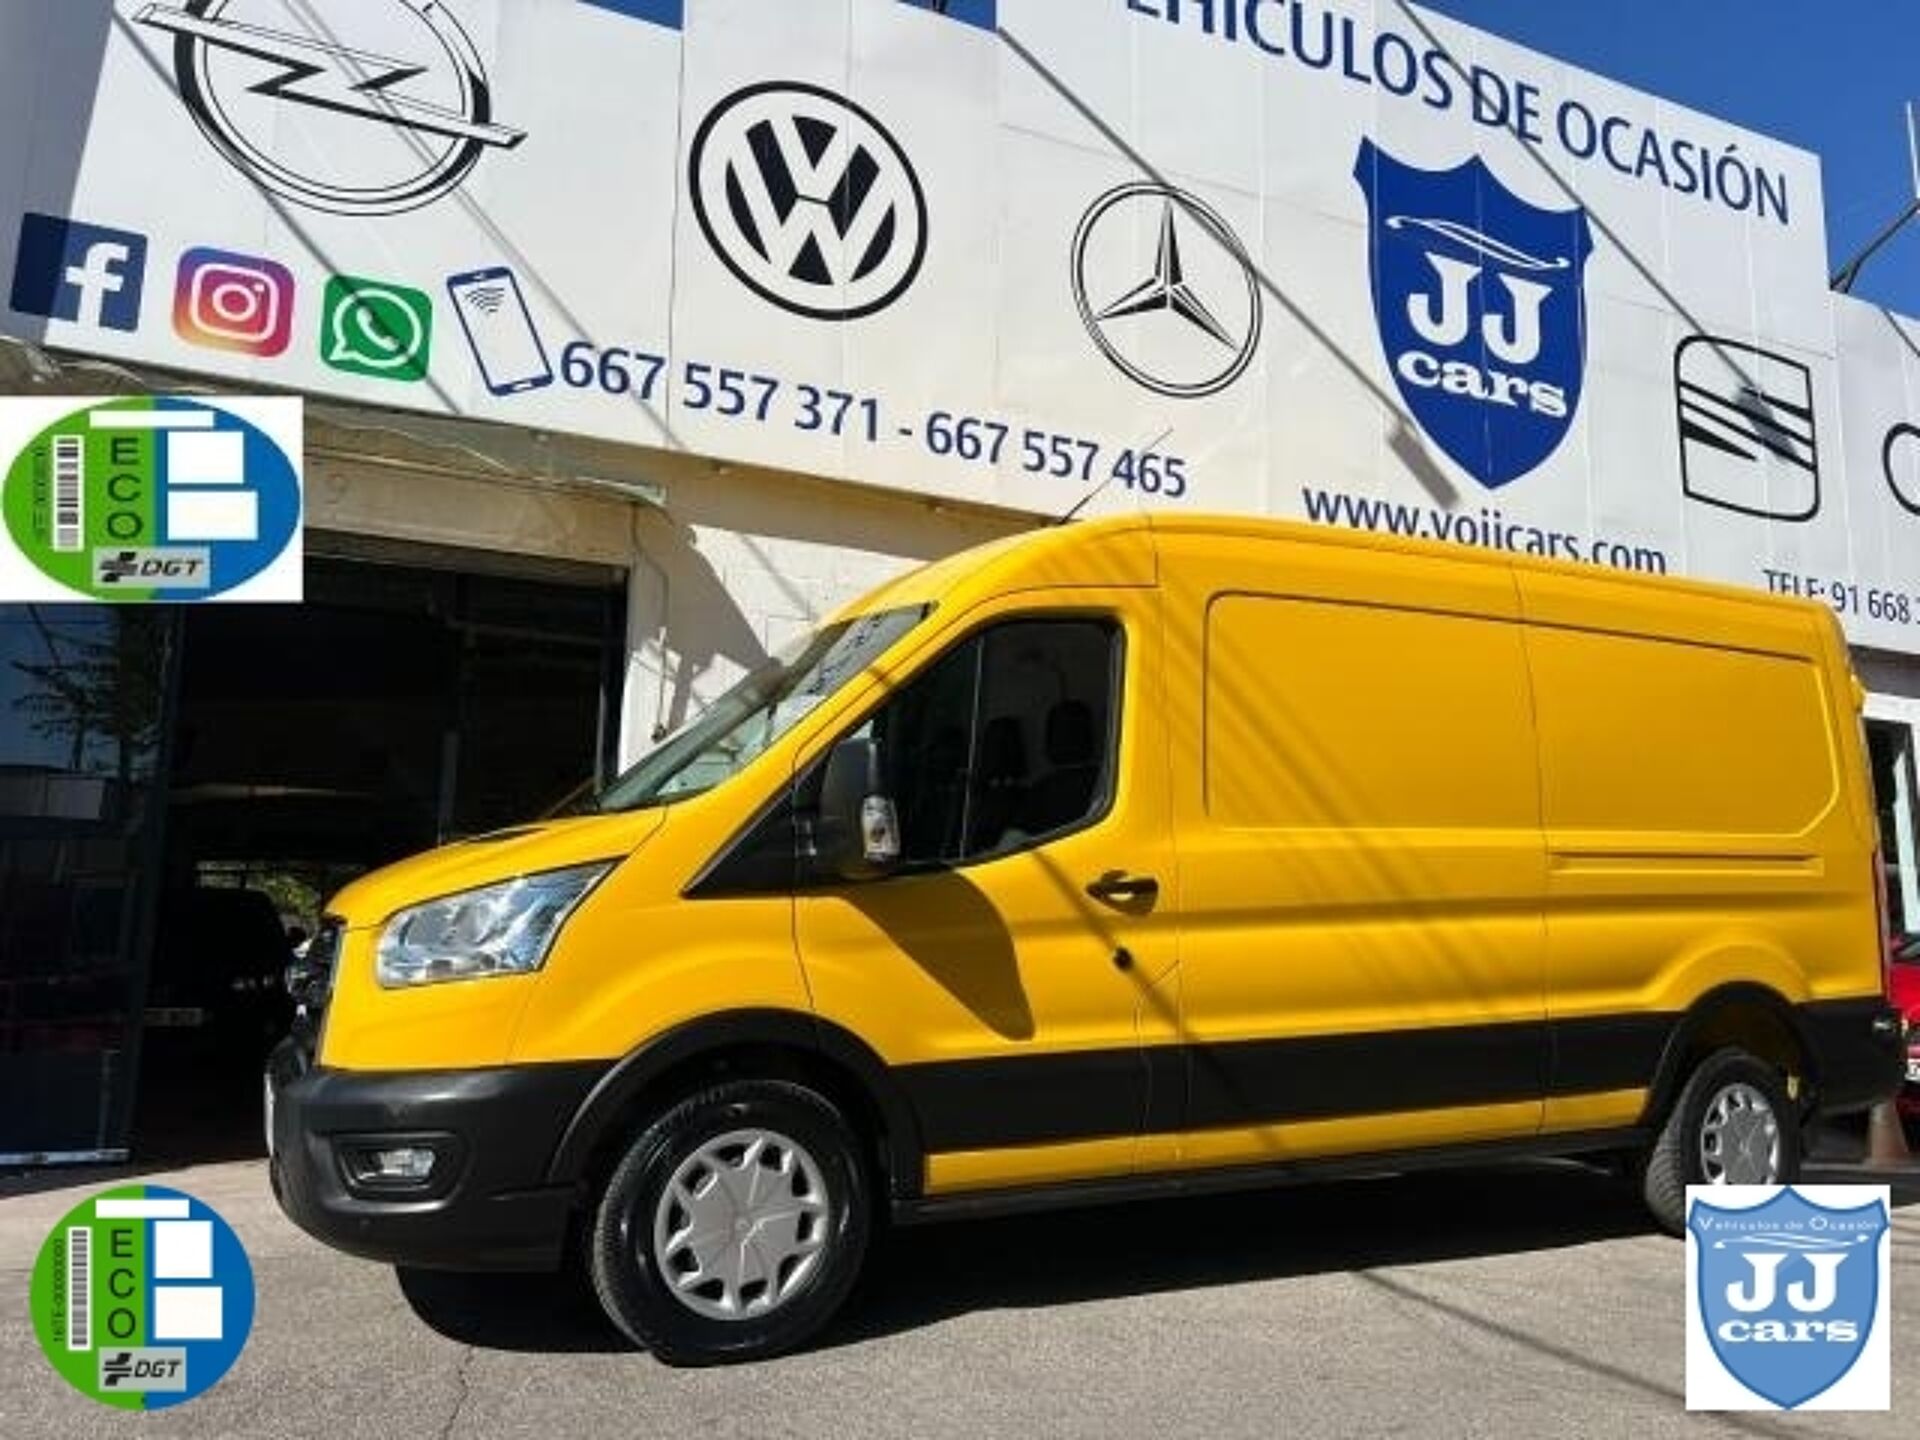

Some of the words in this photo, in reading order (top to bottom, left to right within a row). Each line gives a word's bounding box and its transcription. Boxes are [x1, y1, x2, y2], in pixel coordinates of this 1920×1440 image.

[1471, 65, 1542, 144] DE
[1556, 100, 1788, 226] OCASIÓN
[1407, 251, 1553, 364] JJ
[560, 341, 665, 400] 667
[683, 362, 779, 421] 557
[795, 384, 879, 442] 371
[925, 411, 1009, 465] 667
[1023, 429, 1100, 481] 557
[1111, 449, 1187, 498] 465
[1397, 351, 1567, 418] cars
[1832, 581, 1858, 614] 91
[1868, 590, 1911, 625] 668
